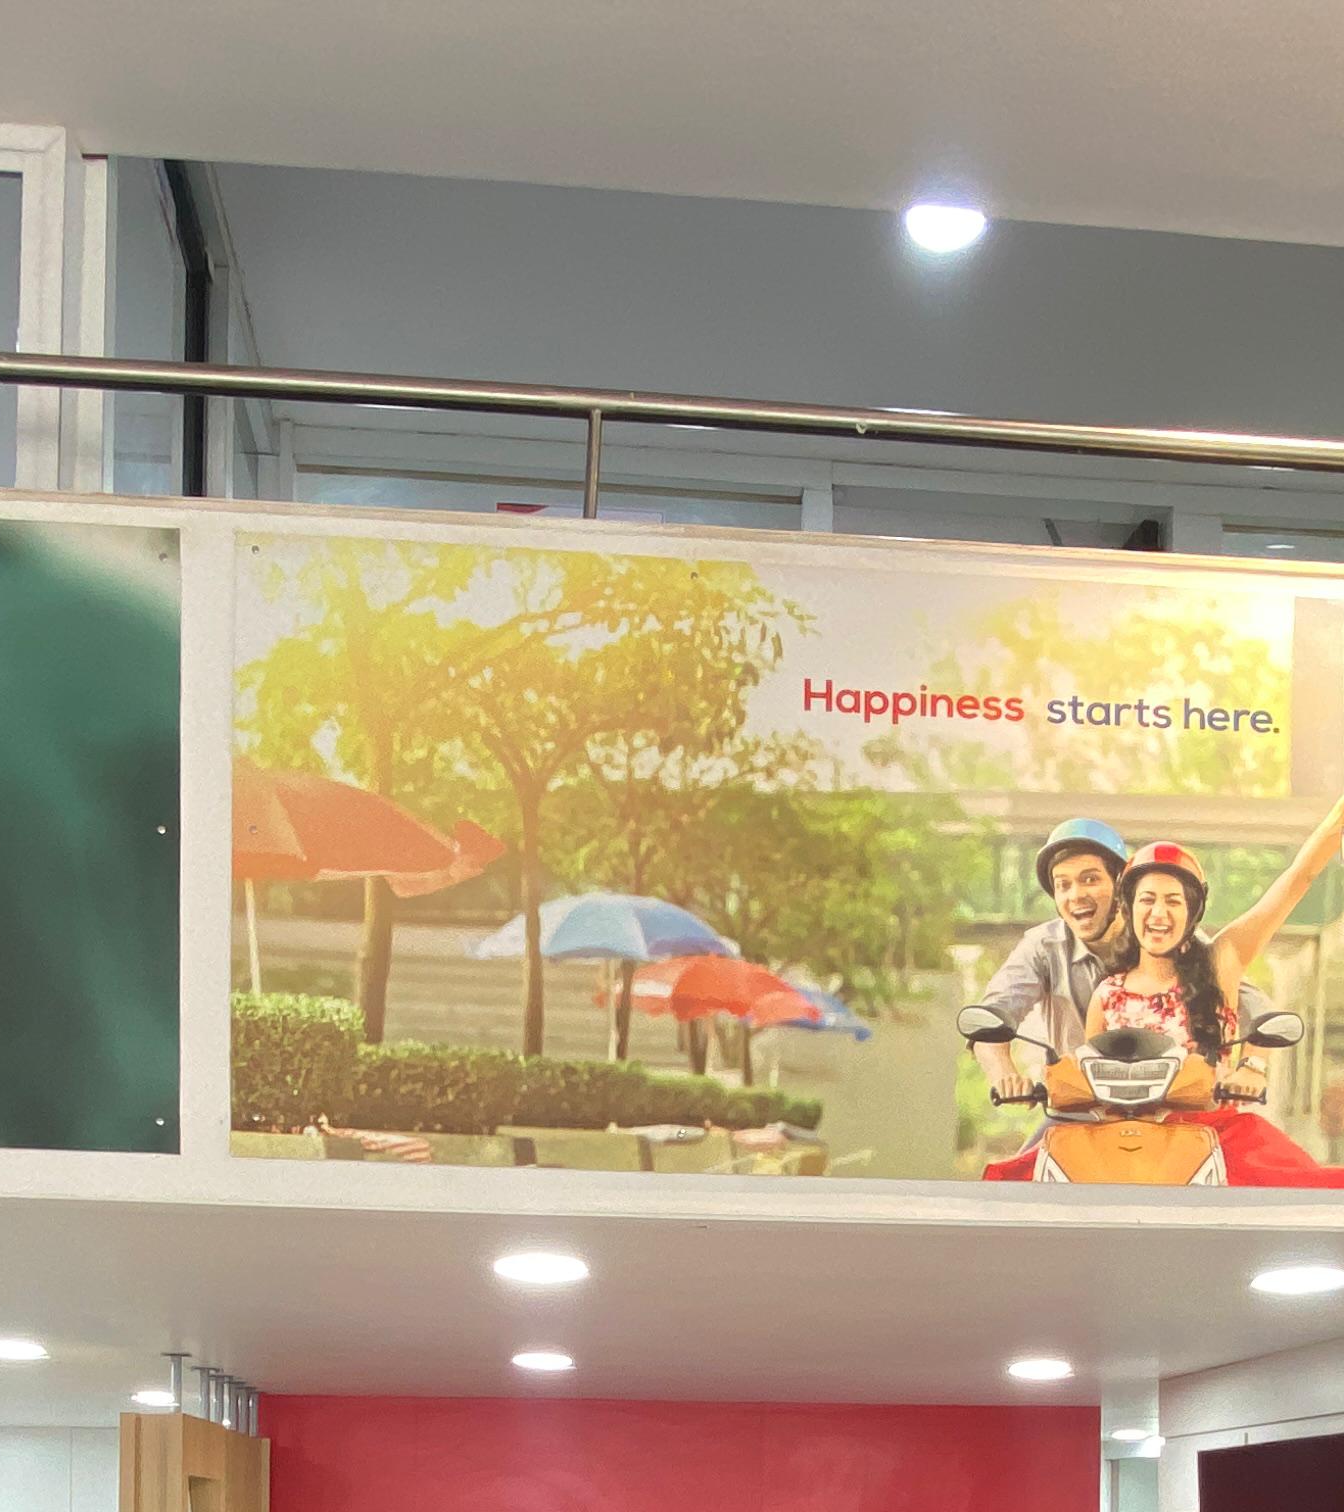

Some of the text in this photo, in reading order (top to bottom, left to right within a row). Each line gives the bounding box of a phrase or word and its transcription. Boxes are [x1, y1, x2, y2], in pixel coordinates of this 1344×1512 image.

[803, 678, 1280, 734] Happiness starts here.
